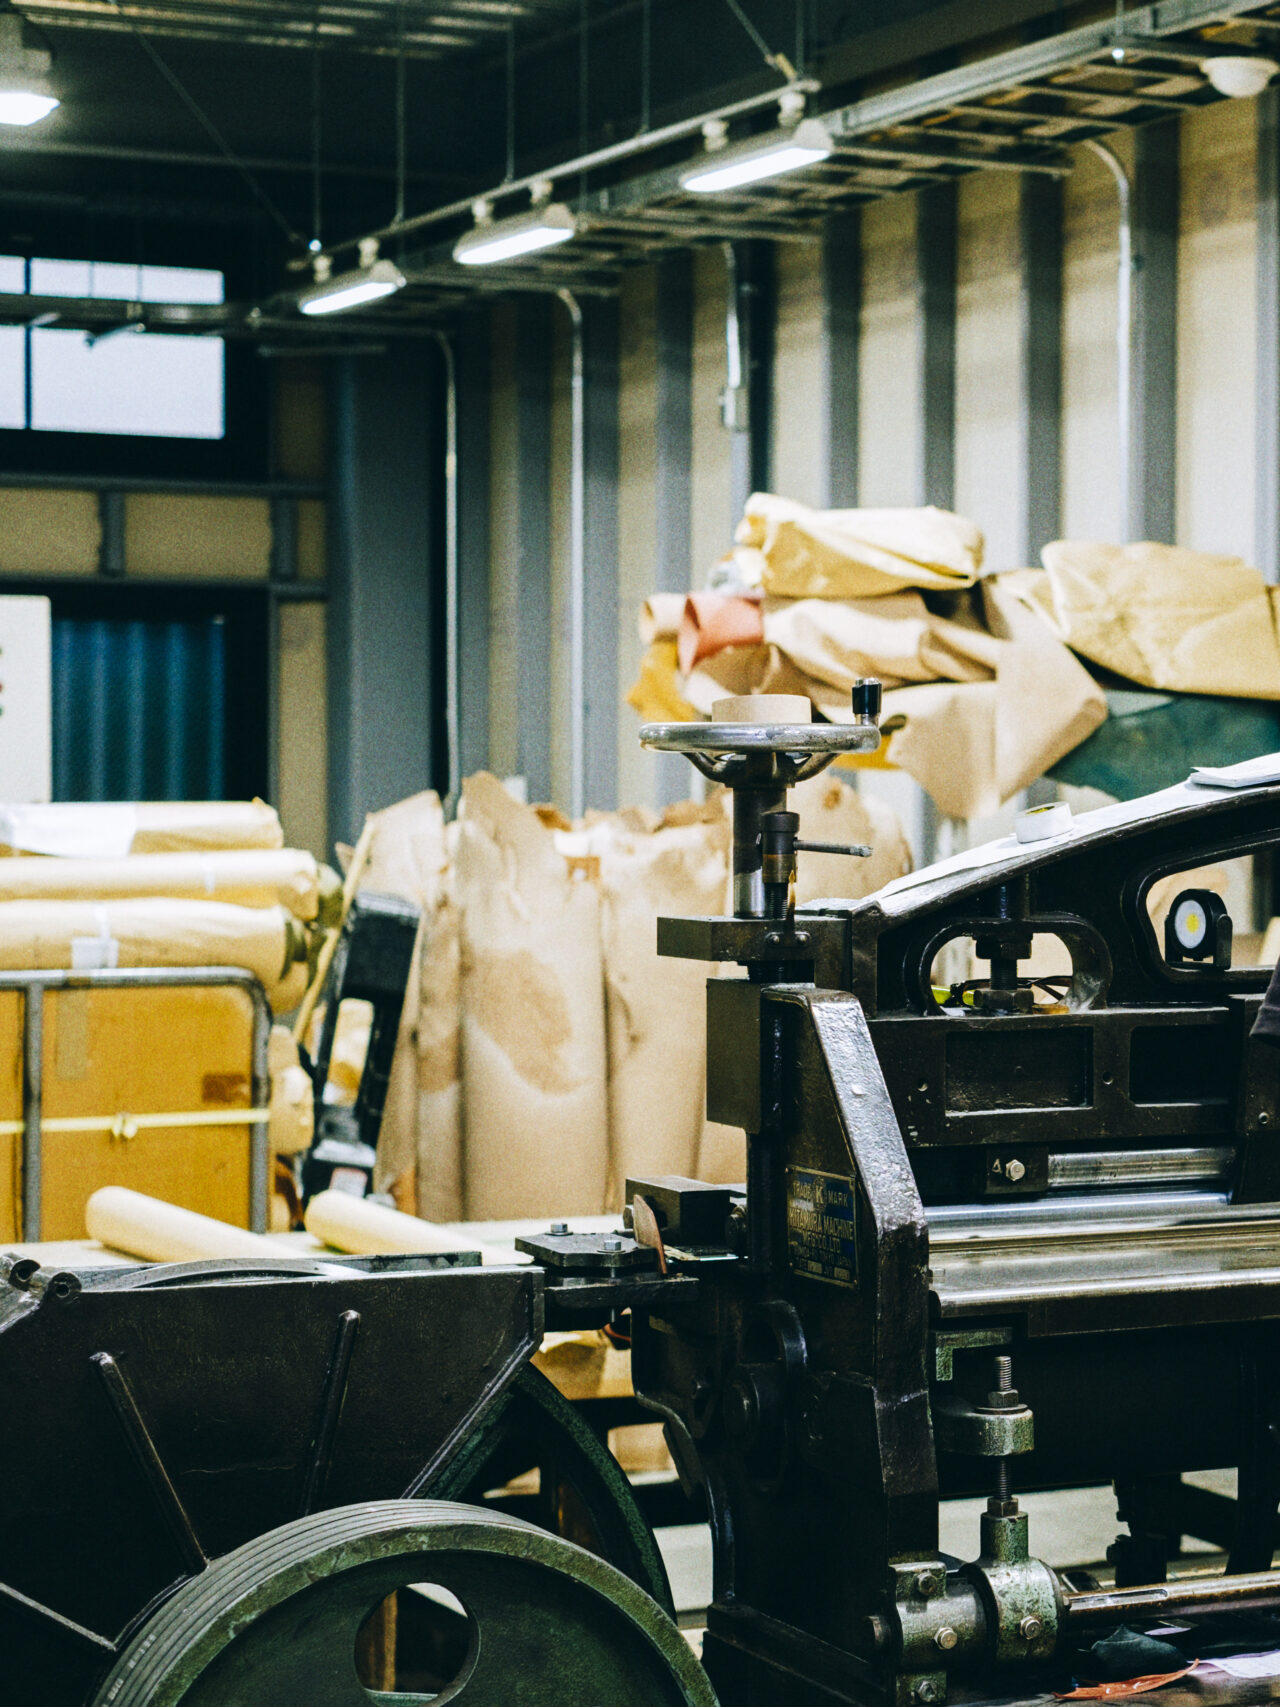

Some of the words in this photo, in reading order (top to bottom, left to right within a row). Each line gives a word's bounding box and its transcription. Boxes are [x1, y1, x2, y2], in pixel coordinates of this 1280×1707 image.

[793, 1181, 811, 1200] TRADE
[815, 1185, 824, 1204] K
[828, 1190, 848, 1207] MARK
[824, 1215, 854, 1240] MACHINE
